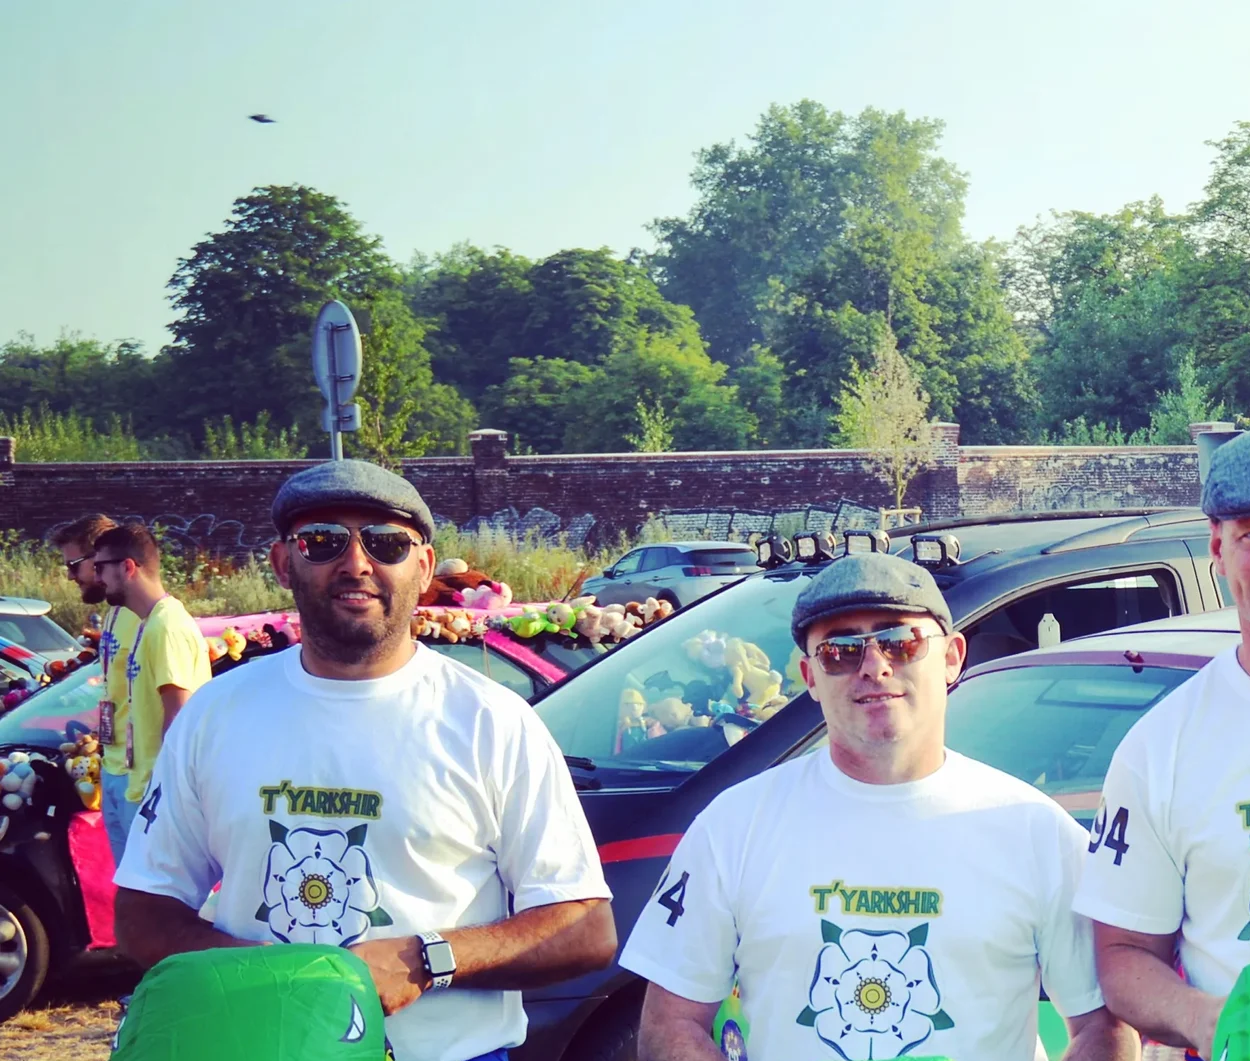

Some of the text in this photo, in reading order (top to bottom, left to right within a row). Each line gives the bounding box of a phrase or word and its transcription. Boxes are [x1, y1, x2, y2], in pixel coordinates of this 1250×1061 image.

[138, 775, 162, 834] 4
[1088, 800, 1130, 866] 94
[652, 868, 690, 927] 4
